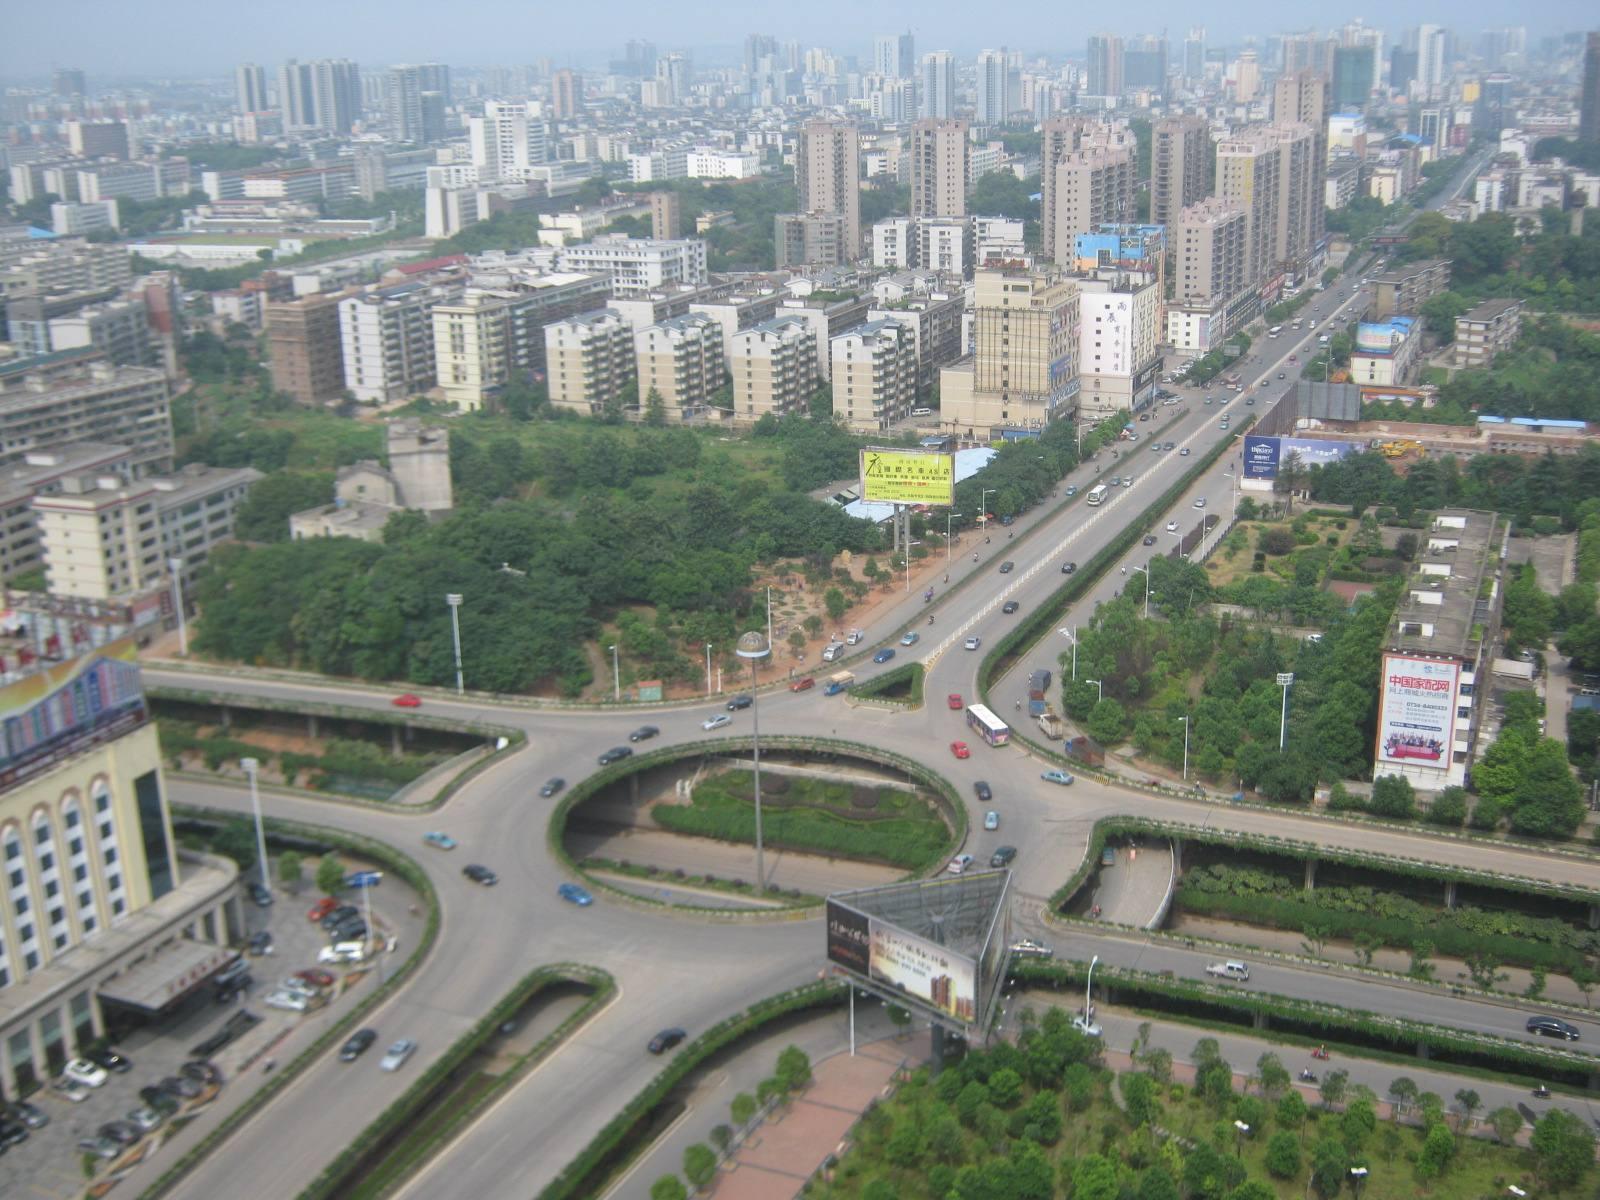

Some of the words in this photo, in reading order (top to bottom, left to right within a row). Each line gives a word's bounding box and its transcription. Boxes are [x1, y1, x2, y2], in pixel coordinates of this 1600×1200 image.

[1389, 674, 1449, 692] 中国家配网
